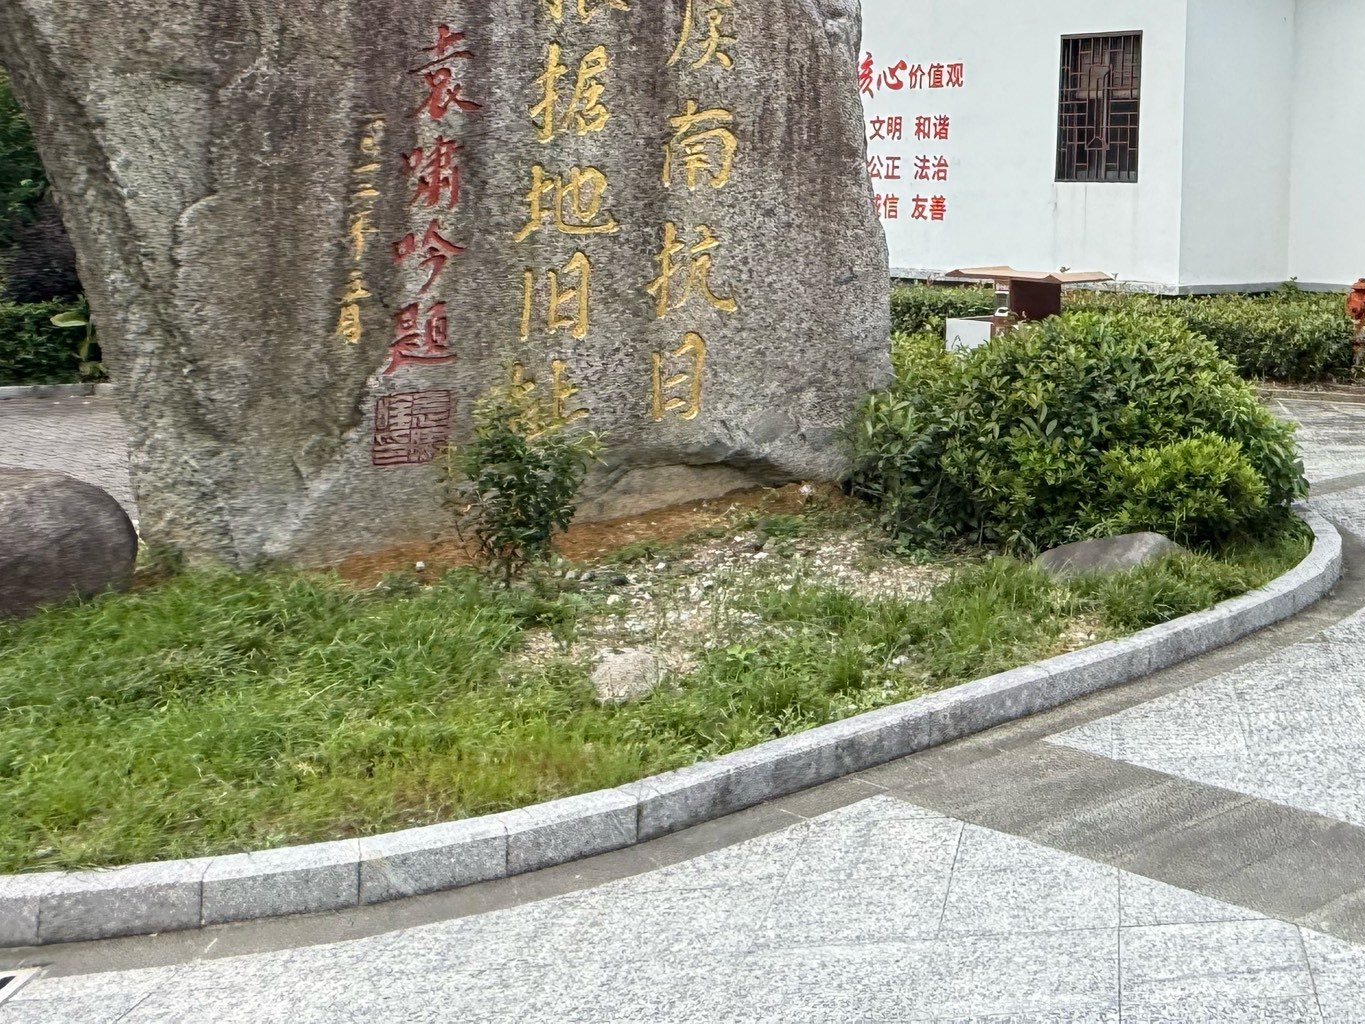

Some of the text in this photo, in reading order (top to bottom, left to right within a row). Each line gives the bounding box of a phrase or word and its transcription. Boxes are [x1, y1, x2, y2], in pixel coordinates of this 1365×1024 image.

[870, 115, 949, 140] 文明 和谐
[867, 155, 949, 181] 公正 法治
[911, 194, 947, 221] 友善
